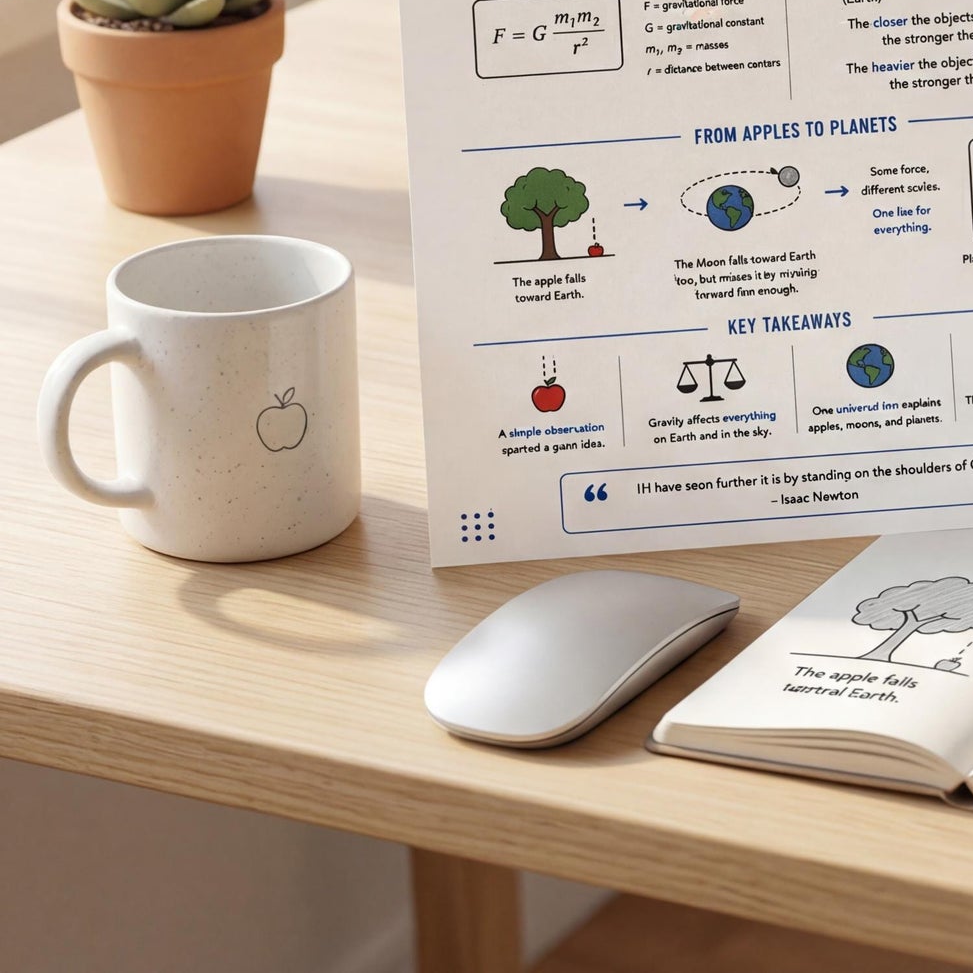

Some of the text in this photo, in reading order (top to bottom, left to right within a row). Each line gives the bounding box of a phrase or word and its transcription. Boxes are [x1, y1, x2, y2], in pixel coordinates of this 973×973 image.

[847, 17, 870, 30] The
[873, 15, 908, 28] closer
[911, 13, 931, 26] the
[493, 26, 547, 44] F G
[694, 115, 897, 145] FROM APPLES TO PLANETS
[870, 164, 930, 177] Some force,
[861, 184, 905, 196] different
[873, 221, 932, 236] everything.
[511, 272, 587, 289] The apple falls
[514, 289, 585, 303] toward Earth.
[727, 311, 852, 335] KEY TAKEAWAYS
[686, 410, 777, 426] affects everything
[653, 425, 772, 444] on Earth and in the sky.
[654, 481, 683, 493] have
[715, 475, 758, 489] further
[760, 474, 769, 486] it
[771, 473, 782, 485] is
[783, 472, 799, 487] by
[801, 469, 852, 483] standing
[854, 469, 870, 479] on
[872, 465, 892, 478] the
[895, 461, 952, 476] shoulders
[954, 458, 968, 472] of
[780, 490, 859, 505] Isaac Newton
